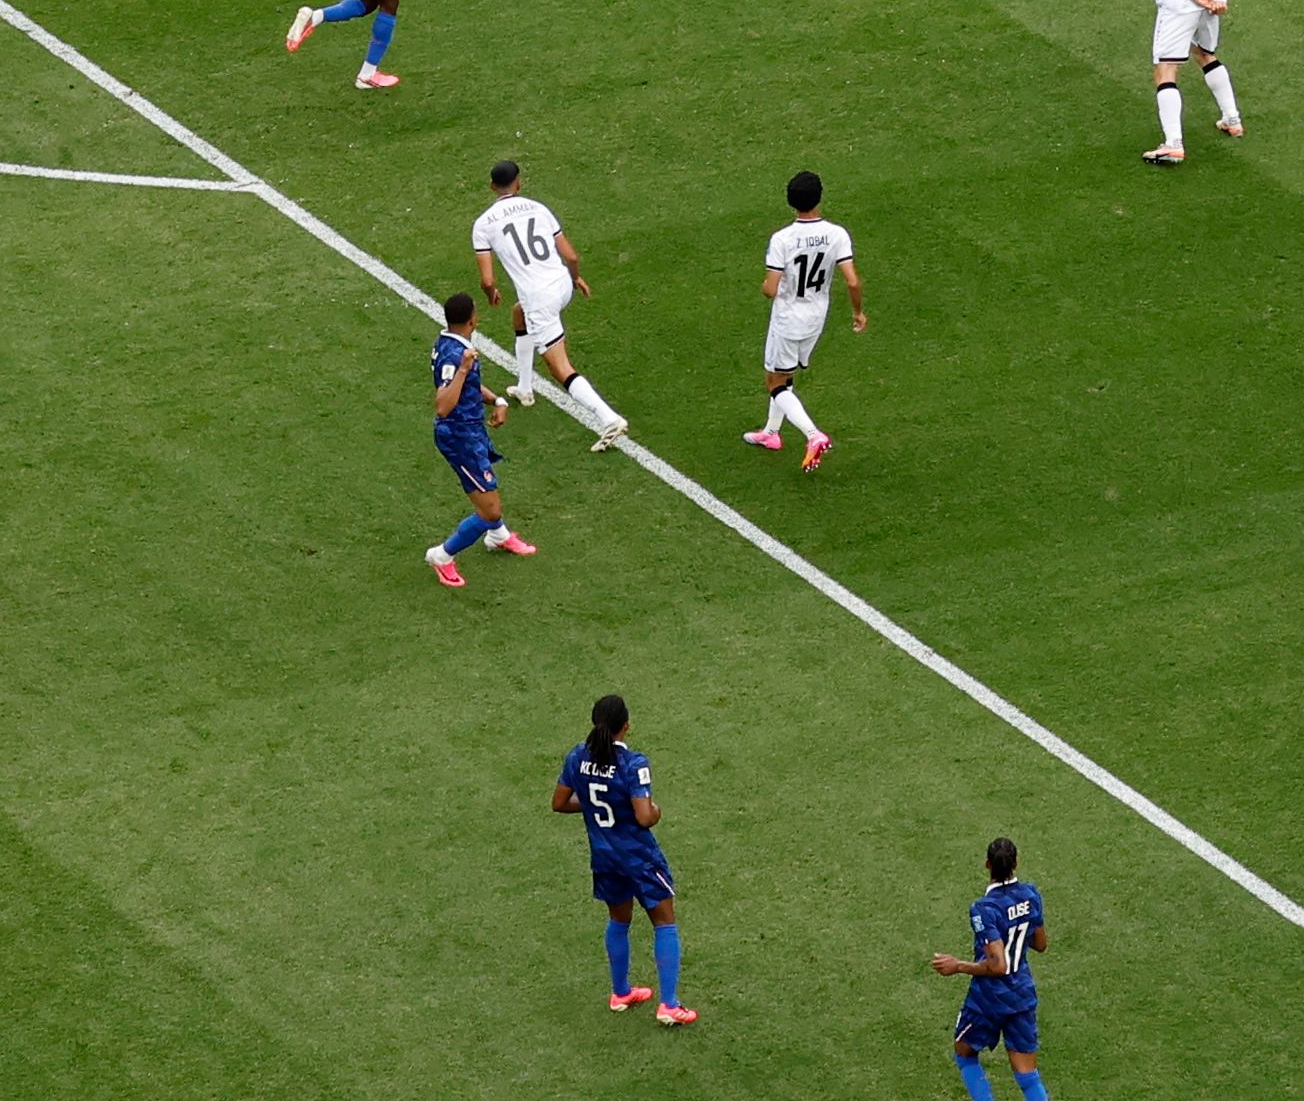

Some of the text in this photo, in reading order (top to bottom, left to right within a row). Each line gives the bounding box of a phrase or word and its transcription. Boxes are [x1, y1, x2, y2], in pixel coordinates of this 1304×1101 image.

[502, 217, 550, 266] 16
[794, 252, 826, 298] 14
[588, 782, 616, 828] 5
[1005, 921, 1030, 975] 11
